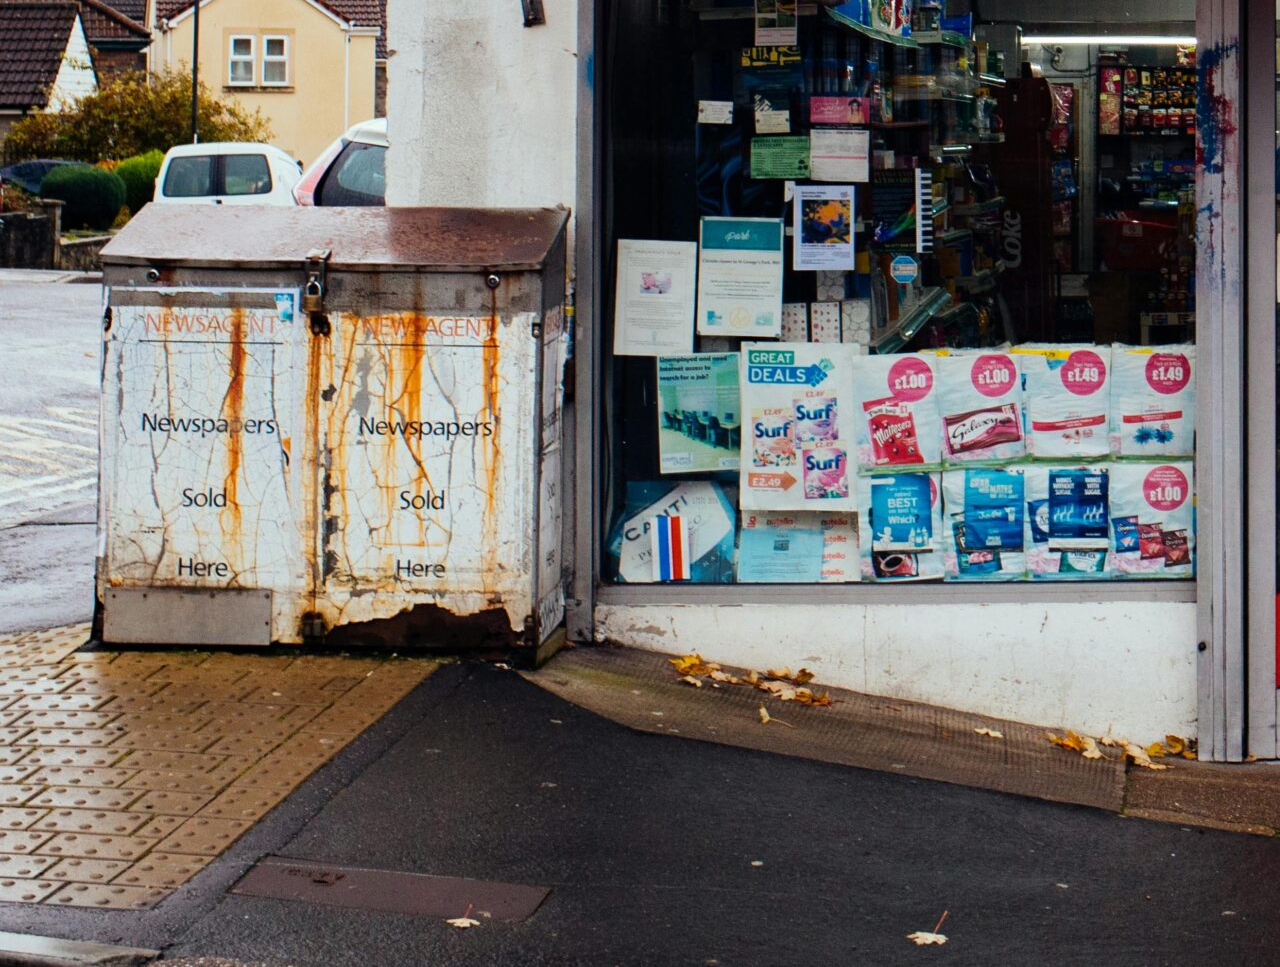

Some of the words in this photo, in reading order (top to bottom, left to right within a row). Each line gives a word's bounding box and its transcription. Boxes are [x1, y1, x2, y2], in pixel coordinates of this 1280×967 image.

[145, 313, 277, 334] NEWSAGENT
[362, 317, 493, 337] NEWAGENT
[751, 353, 792, 364] GREAT
[751, 368, 806, 382] DEALS
[978, 369, 1010, 385] £1.00
[1068, 367, 1099, 383] £1.49
[1152, 366, 1183, 381] £1.49
[895, 374, 926, 390] £1.00
[796, 404, 834, 421] Surf
[141, 413, 276, 438] Newspapers
[359, 416, 493, 441] Newspapers
[754, 422, 791, 438] Surf
[874, 420, 912, 447] Maltesers
[952, 416, 999, 441] Galaxy
[806, 455, 842, 471] Surf
[752, 477, 781, 487] £2.49
[182, 488, 228, 509] Sold
[400, 490, 445, 511] Sold
[1150, 487, 1182, 501] £1.00
[887, 498, 918, 508] BEST
[766, 517, 794, 526] nutella
[821, 518, 849, 526] nutella
[887, 514, 920, 524] Which?
[177, 557, 229, 578] Here
[396, 559, 446, 579] Here
